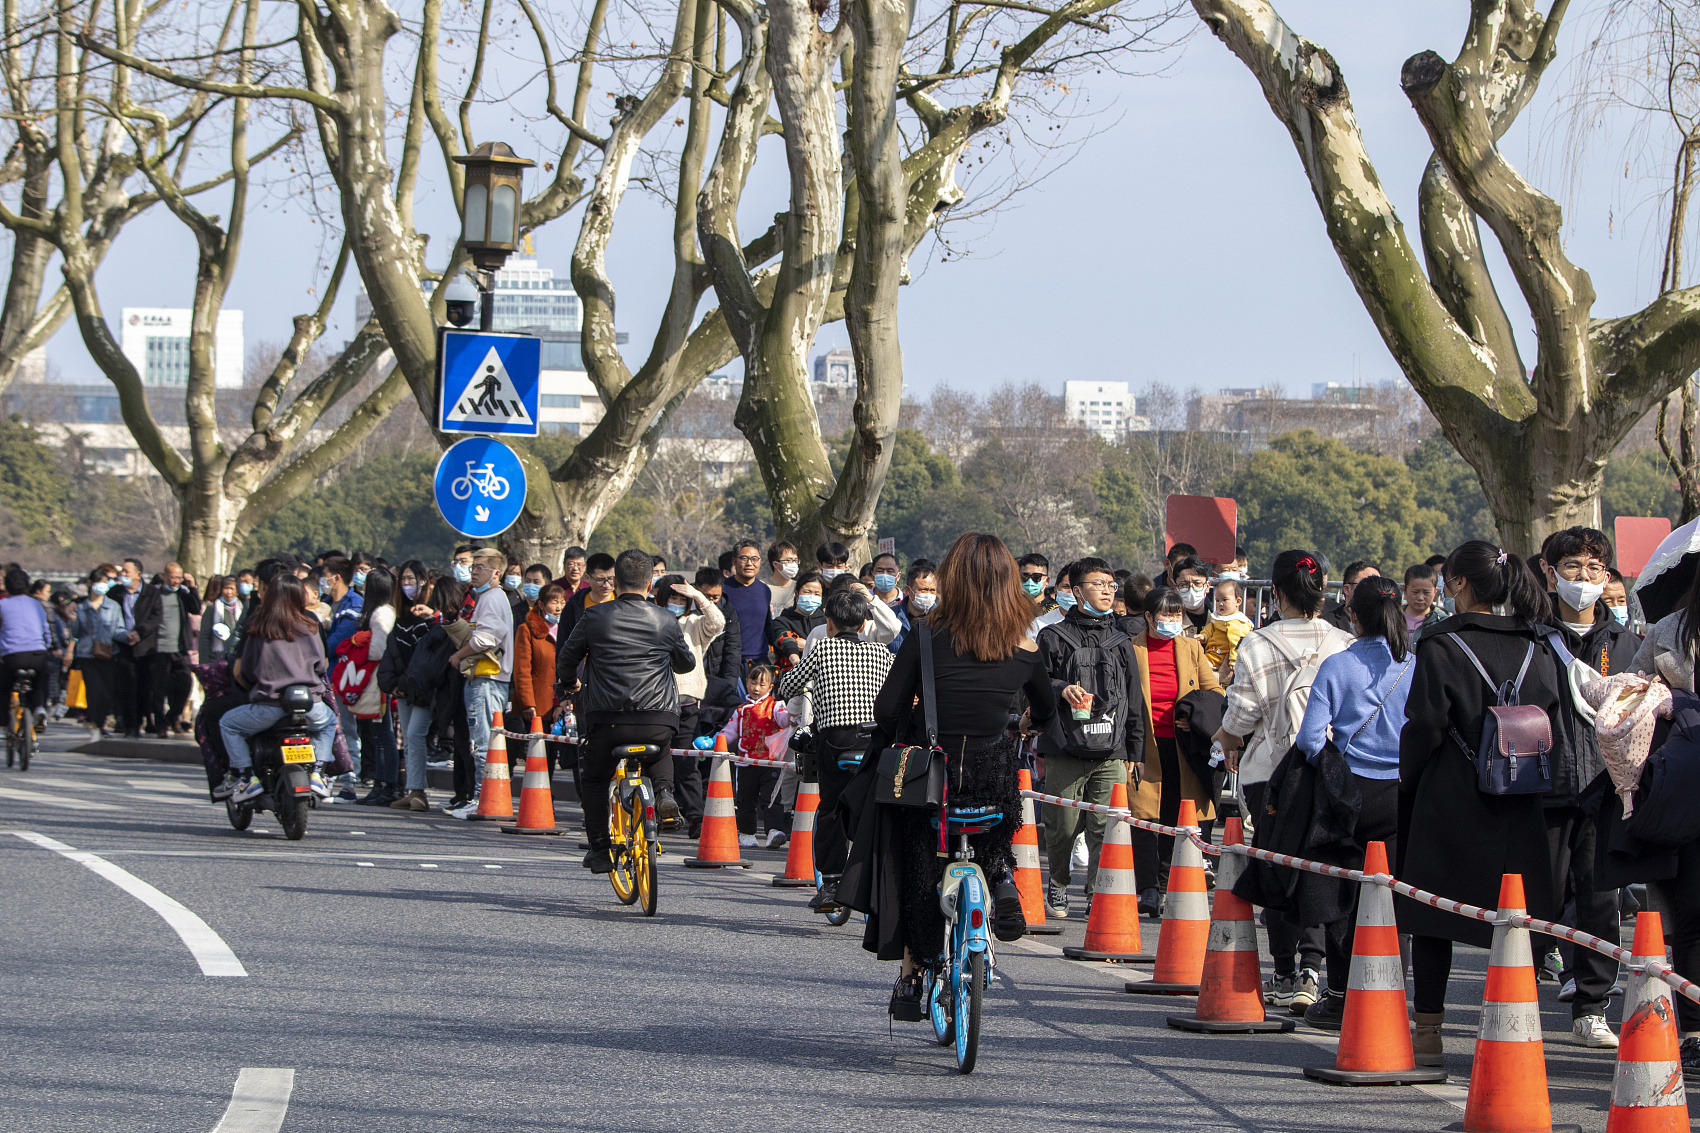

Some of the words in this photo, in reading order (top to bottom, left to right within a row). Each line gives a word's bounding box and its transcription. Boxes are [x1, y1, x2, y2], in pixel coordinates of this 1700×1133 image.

[1083, 722, 1112, 734] PUMA
[1363, 962, 1402, 983] 杭州交
